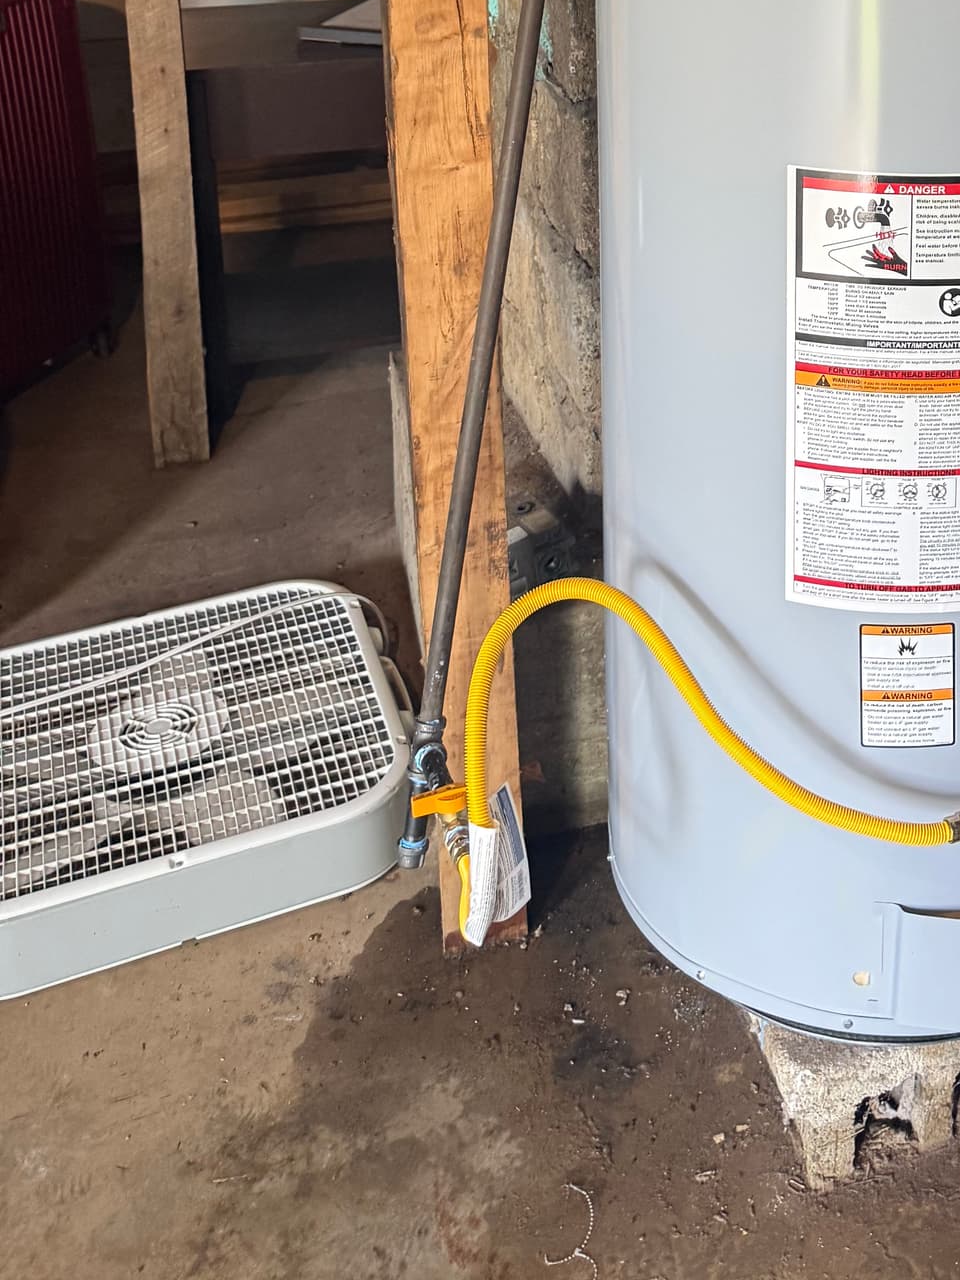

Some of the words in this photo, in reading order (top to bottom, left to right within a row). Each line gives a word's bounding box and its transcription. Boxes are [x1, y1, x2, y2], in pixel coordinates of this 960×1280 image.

[899, 185, 946, 195] DANGER
[884, 263, 907, 271] BURN
[828, 367, 845, 375] FOR
[847, 368, 868, 376] YOUR
[901, 370, 923, 378] READ
[925, 370, 955, 378] BEFORE
[879, 584, 894, 592] OFF
[914, 584, 925, 592] TO
